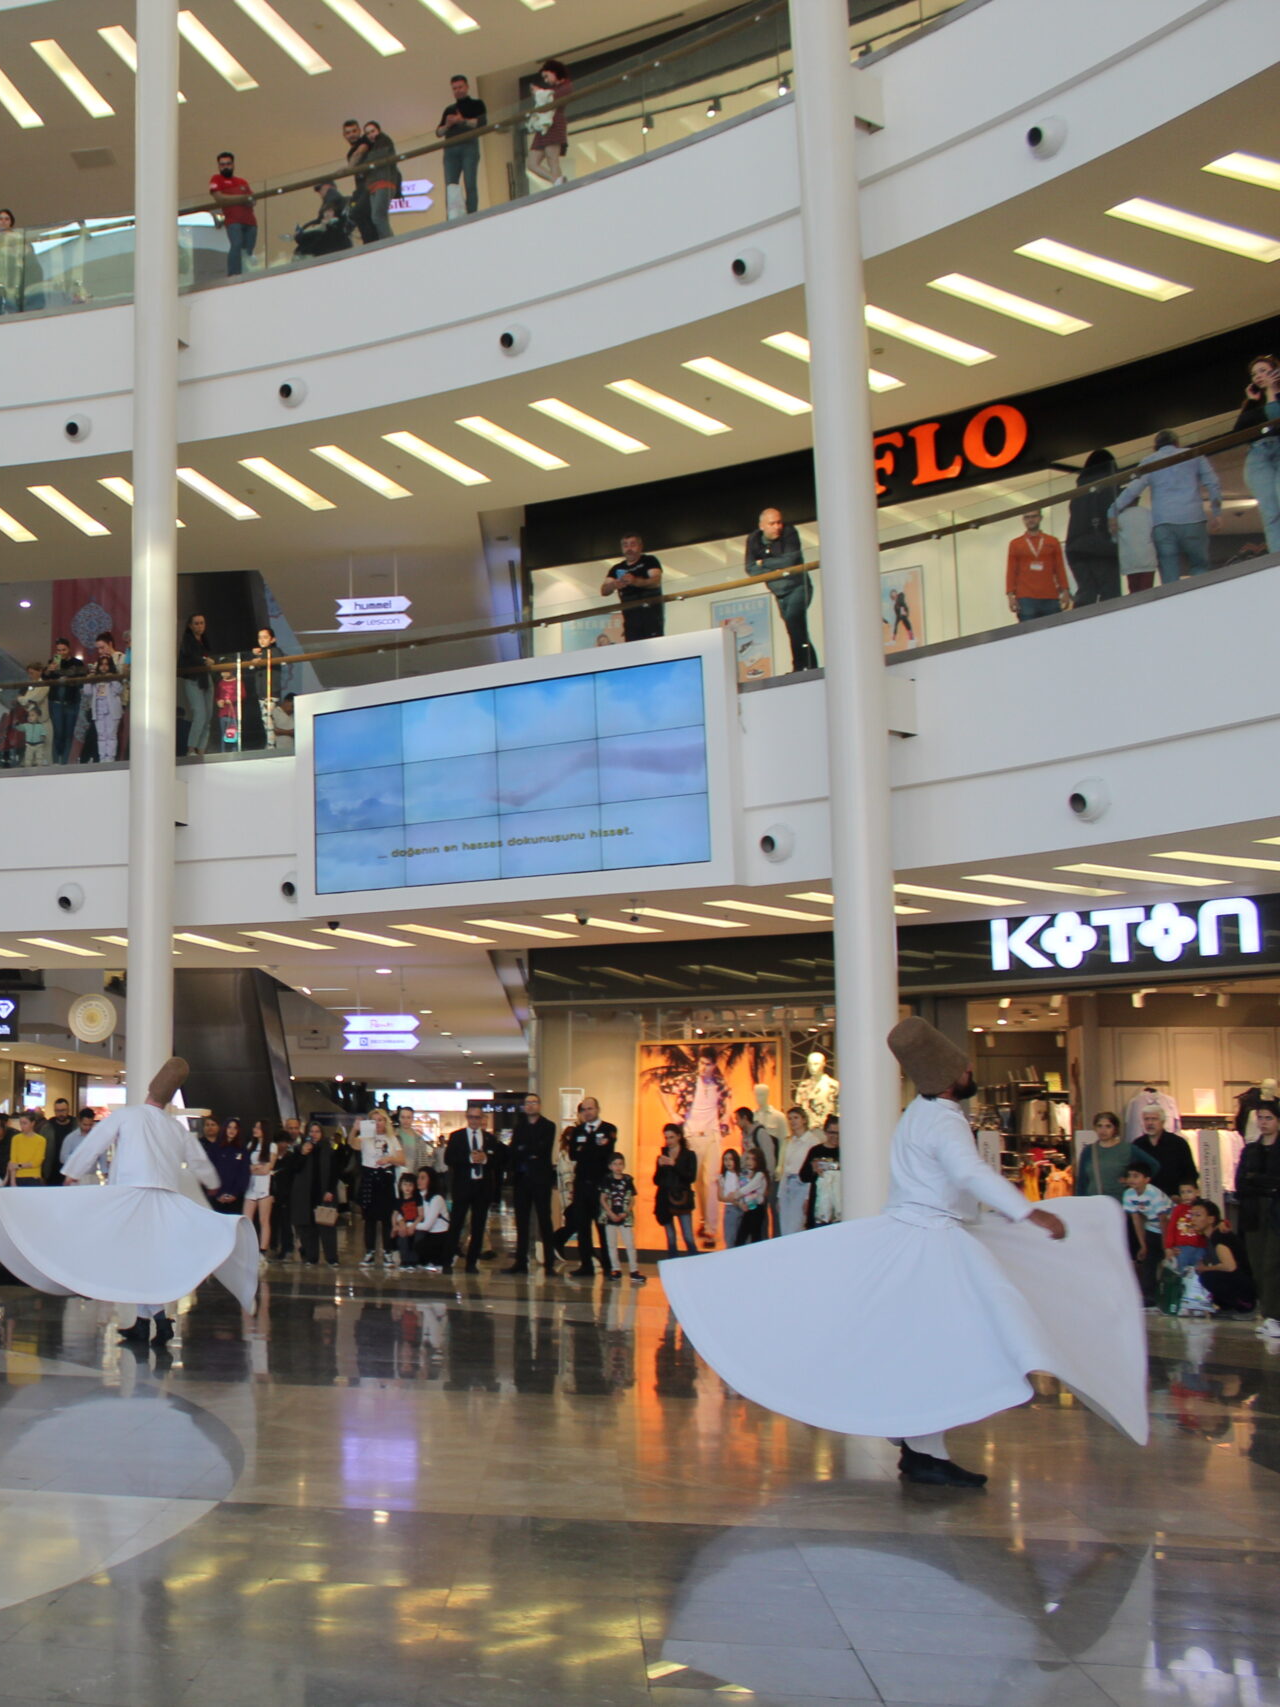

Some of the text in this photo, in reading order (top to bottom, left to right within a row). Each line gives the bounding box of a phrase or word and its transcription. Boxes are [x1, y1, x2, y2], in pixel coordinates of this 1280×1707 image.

[873, 404, 1028, 495] FLO
[354, 600, 392, 610] hummel
[443, 844, 458, 852] en
[462, 840, 503, 850] hassas
[990, 897, 1261, 971] KOTON
